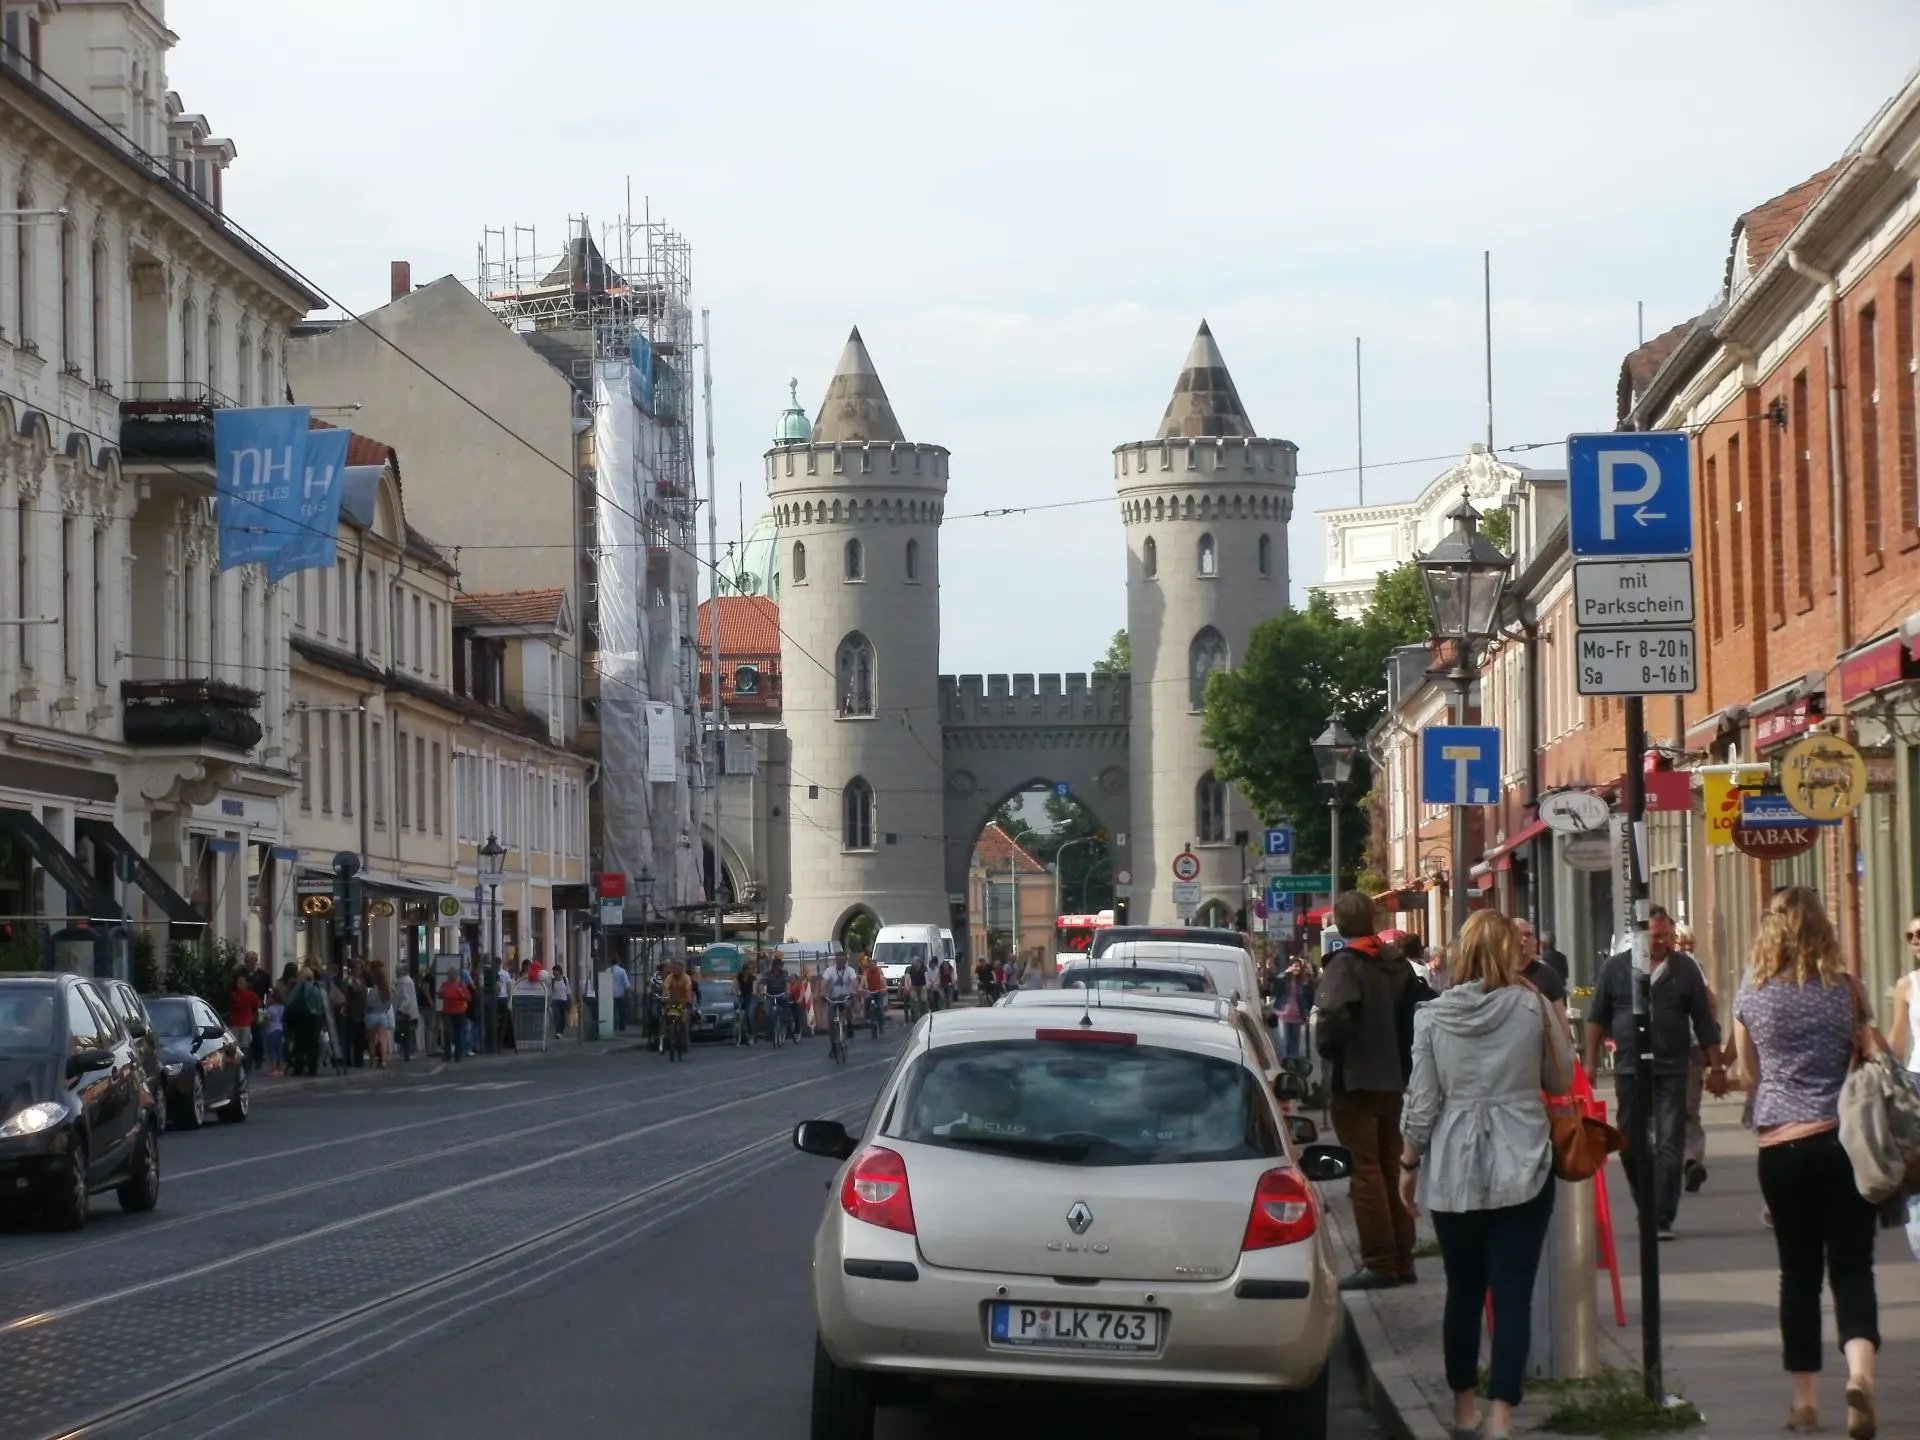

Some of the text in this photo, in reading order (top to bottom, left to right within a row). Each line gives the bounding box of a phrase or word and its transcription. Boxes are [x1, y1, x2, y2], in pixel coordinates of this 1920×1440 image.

[231, 486, 291, 505] HOTELES
[1597, 450, 1661, 540] P
[1619, 572, 1648, 589] mit
[1585, 596, 1684, 615] Parkschein
[1583, 641, 1632, 659] Mo-Fr
[1585, 667, 1604, 685] Sa
[1269, 832, 1285, 853] P
[1740, 828, 1809, 845] TABAK
[1047, 1241, 1110, 1254] CLIO
[1020, 1309, 1036, 1335] P
[1096, 1313, 1147, 1341] 763
